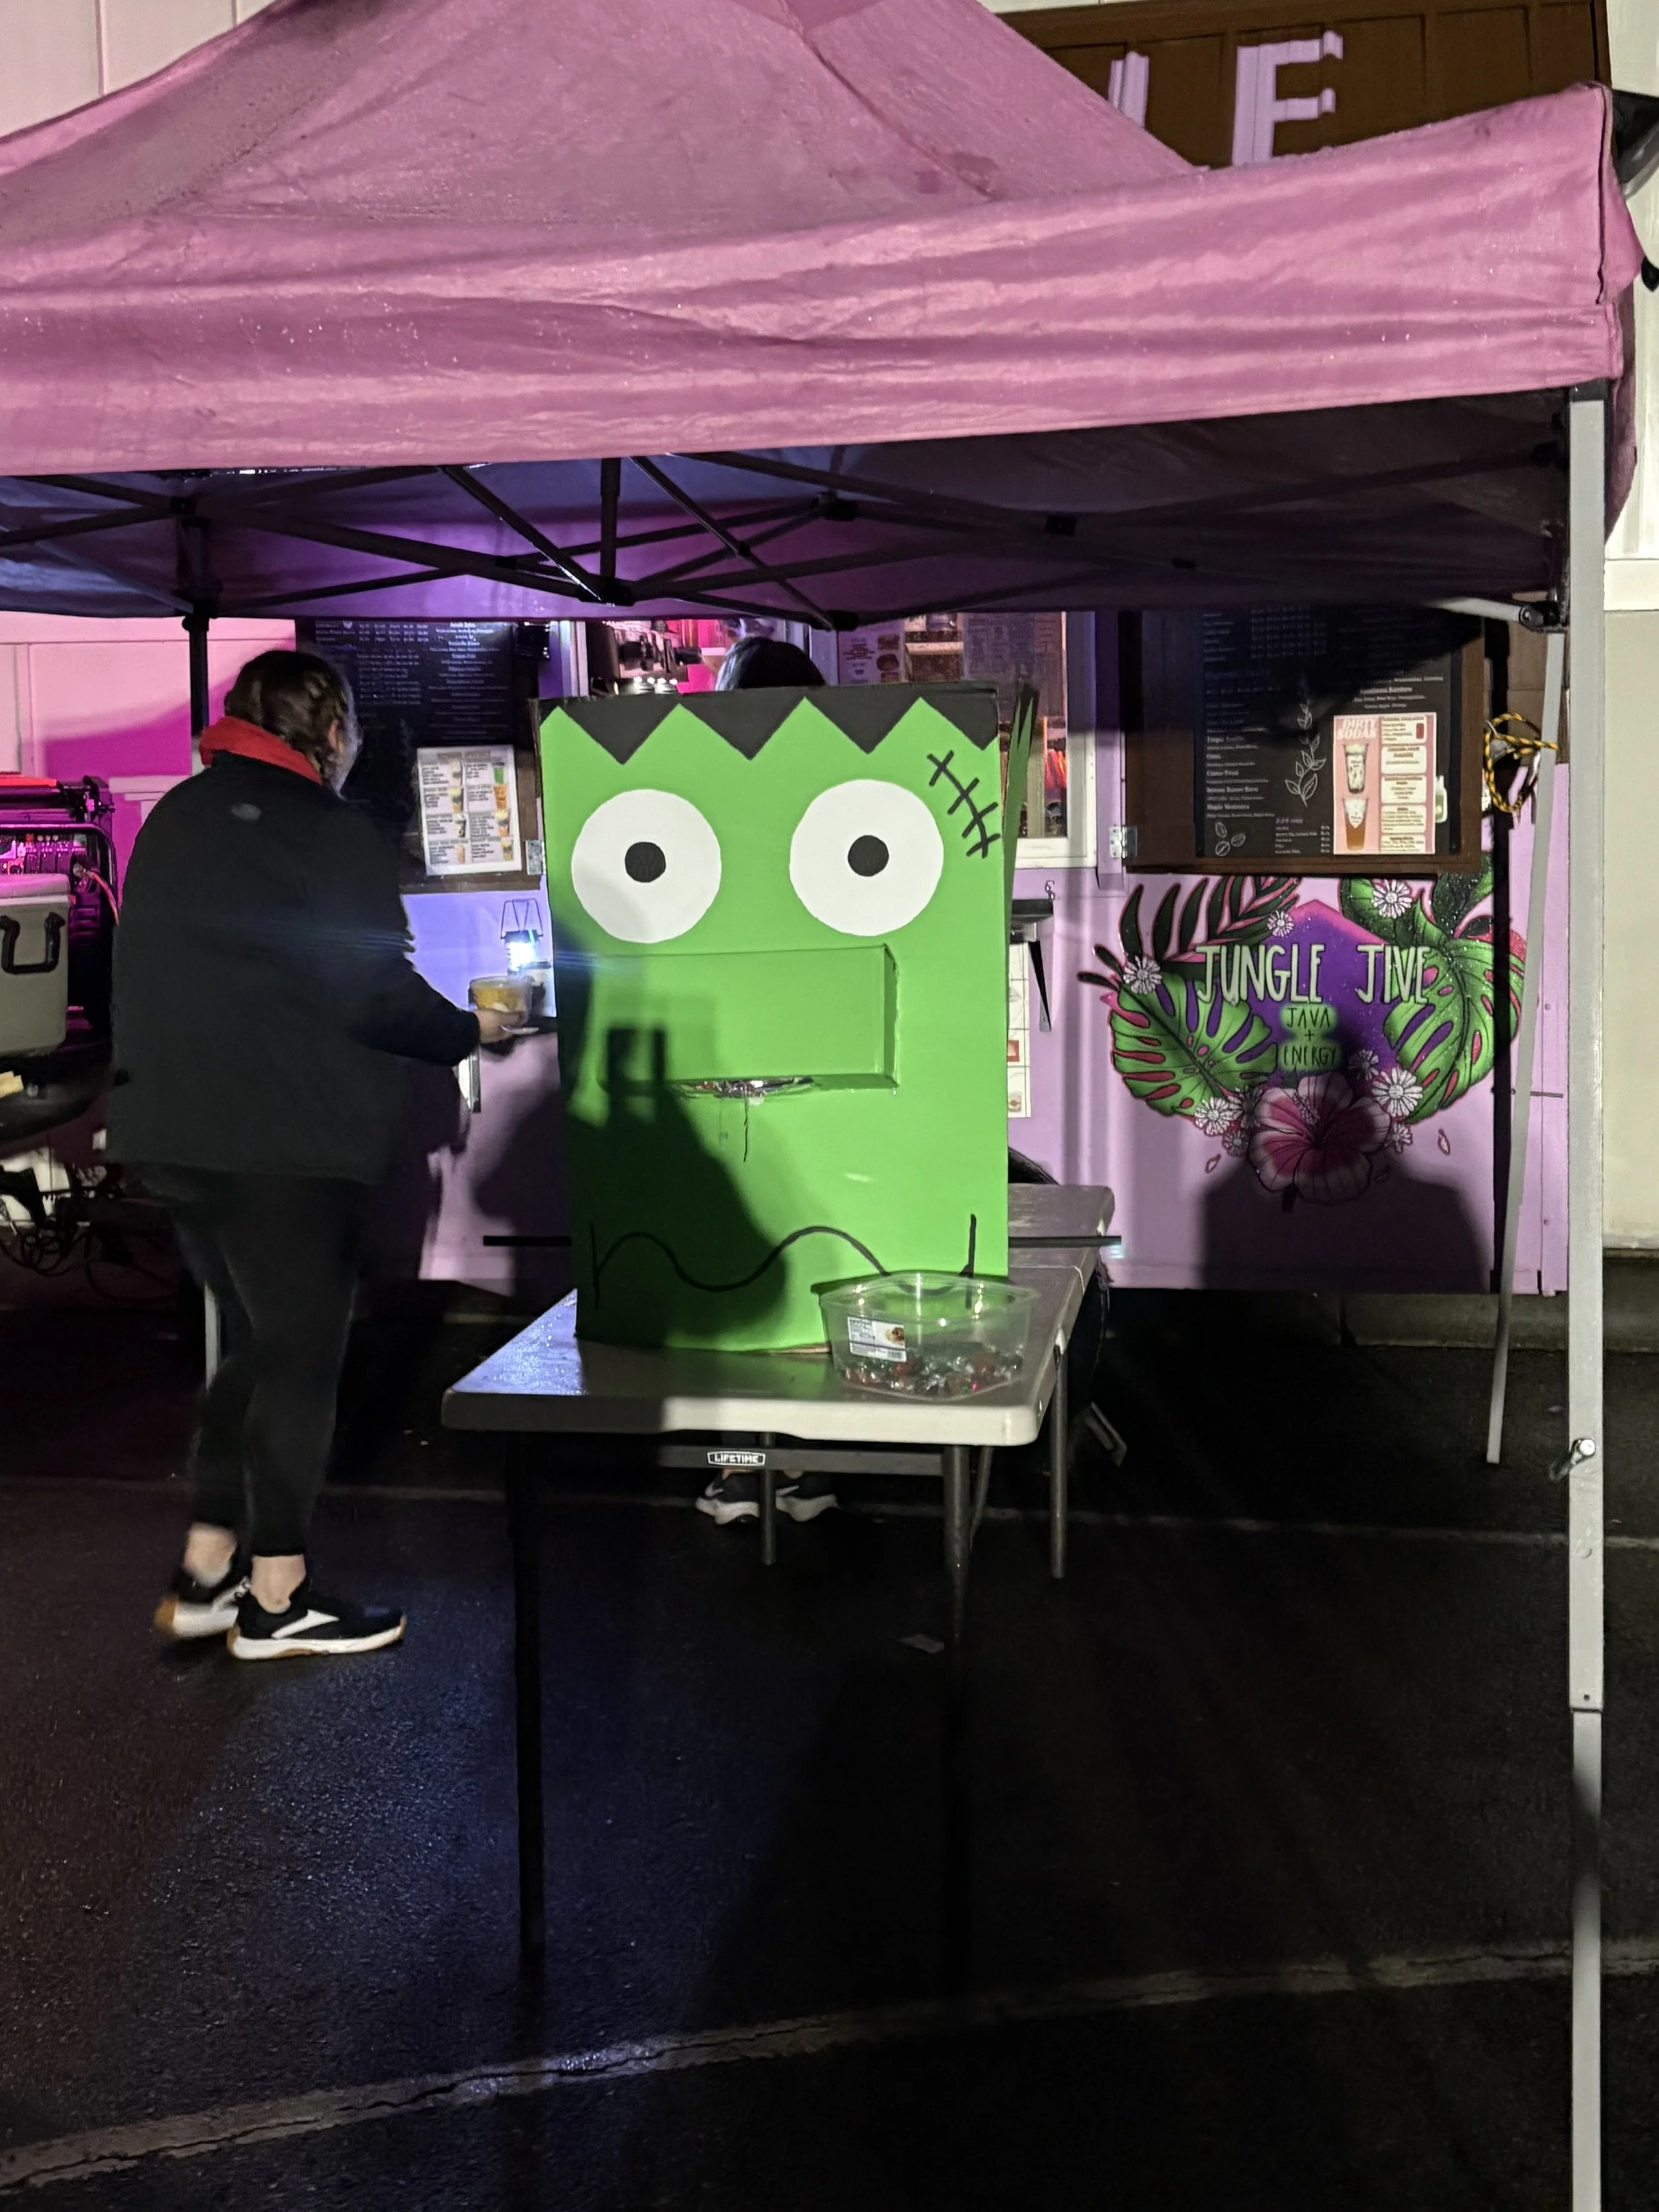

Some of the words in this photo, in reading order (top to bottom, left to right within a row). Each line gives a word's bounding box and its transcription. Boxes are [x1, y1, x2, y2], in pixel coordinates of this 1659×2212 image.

[1195, 943, 1326, 1007] JUNGLE
[1355, 943, 1431, 1004] JIVE
[1286, 1006, 1331, 1029] JAVA
[1283, 1045, 1337, 1067] ENERGY
[715, 1453, 758, 1463] LIFETIME
